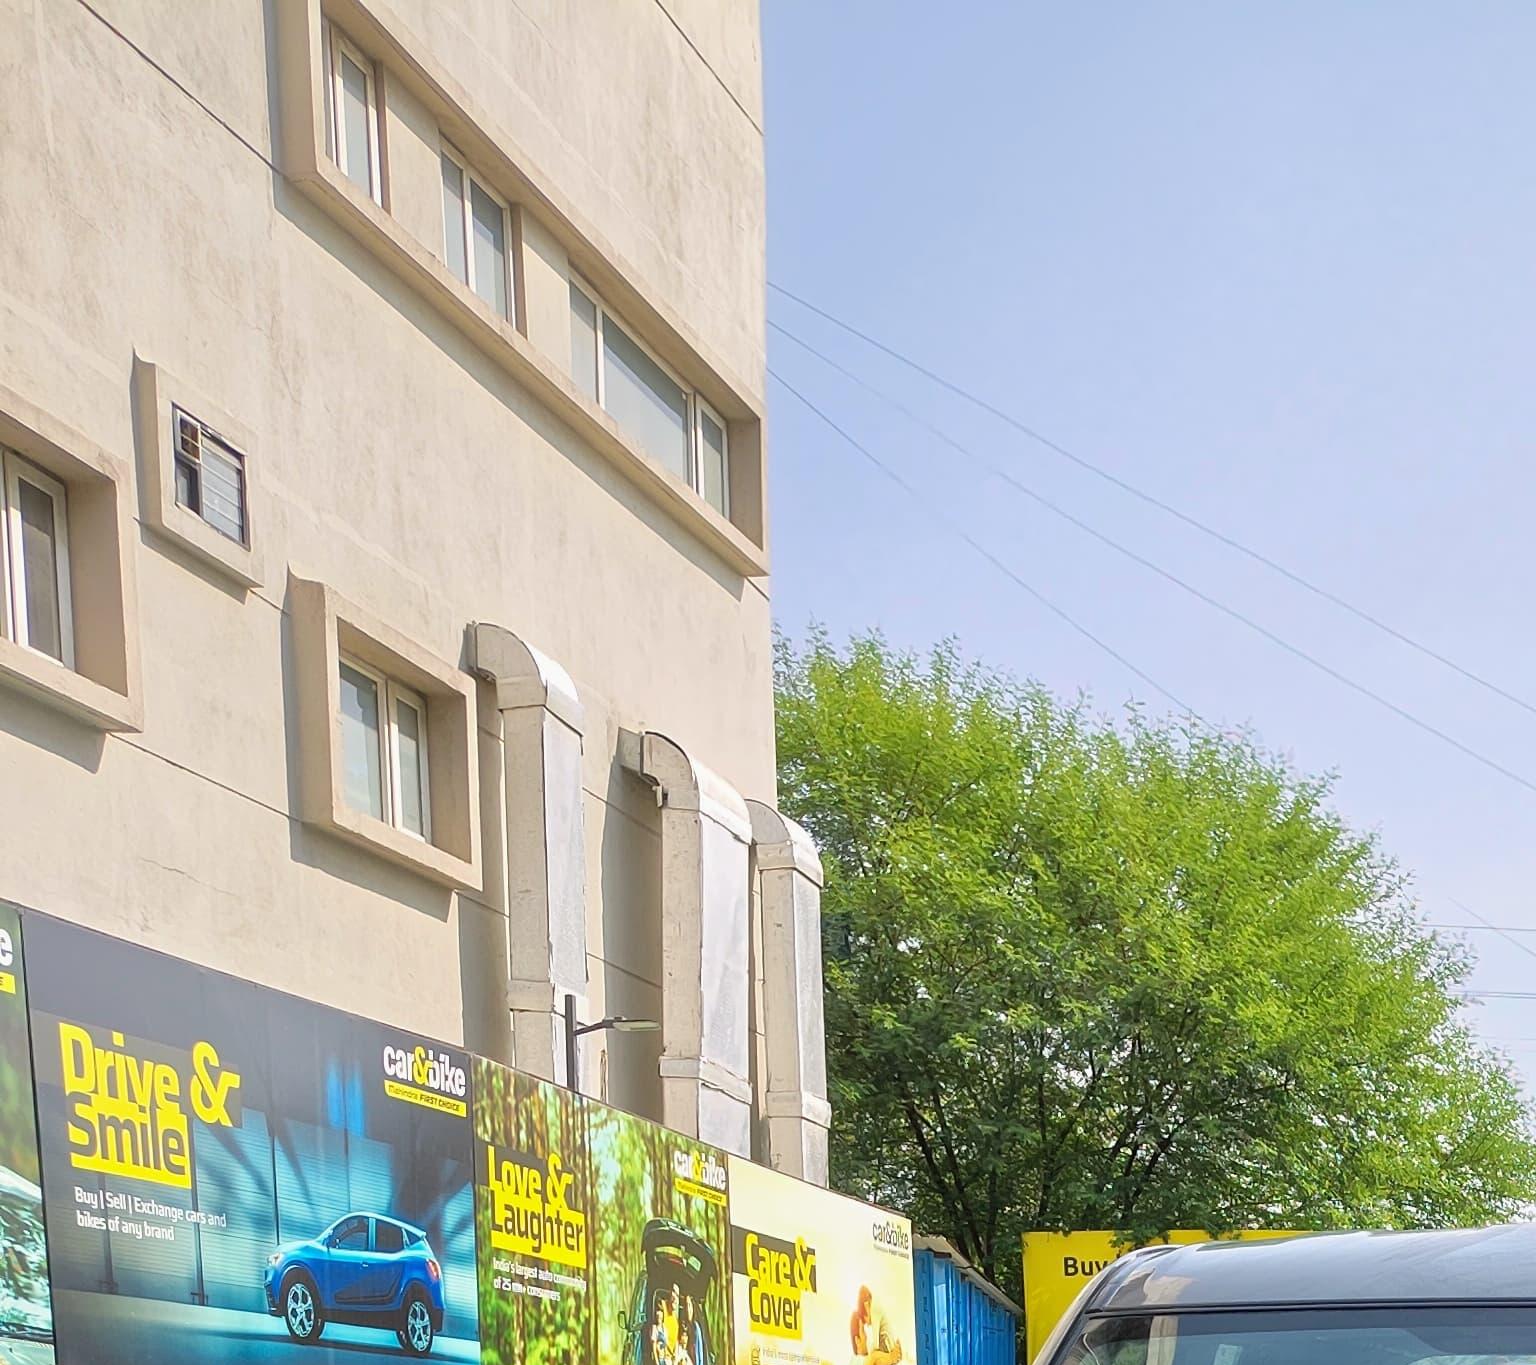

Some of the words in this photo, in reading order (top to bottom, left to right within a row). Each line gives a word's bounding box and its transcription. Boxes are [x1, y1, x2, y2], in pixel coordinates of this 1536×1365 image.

[59, 1022, 180, 1110] Drive
[191, 1041, 240, 1127] &
[384, 1046, 466, 1097] car&bike
[66, 1091, 187, 1176] Smile
[487, 1144, 542, 1201] Love
[546, 1152, 574, 1210] &
[674, 1150, 726, 1191] car&bike
[74, 1186, 98, 1210] Buy
[105, 1191, 126, 1211] Sell
[134, 1196, 184, 1223] Exchange
[185, 1210, 206, 1225] cars
[208, 1212, 227, 1228] and
[76, 1209, 106, 1230] bikes
[108, 1215, 121, 1233] of
[122, 1220, 142, 1240] any
[144, 1220, 175, 1241] brand
[491, 1190, 584, 1253] Laughter
[745, 1232, 791, 1288] Care
[873, 1221, 909, 1250] car&bike
[748, 1278, 800, 1331] Cover
